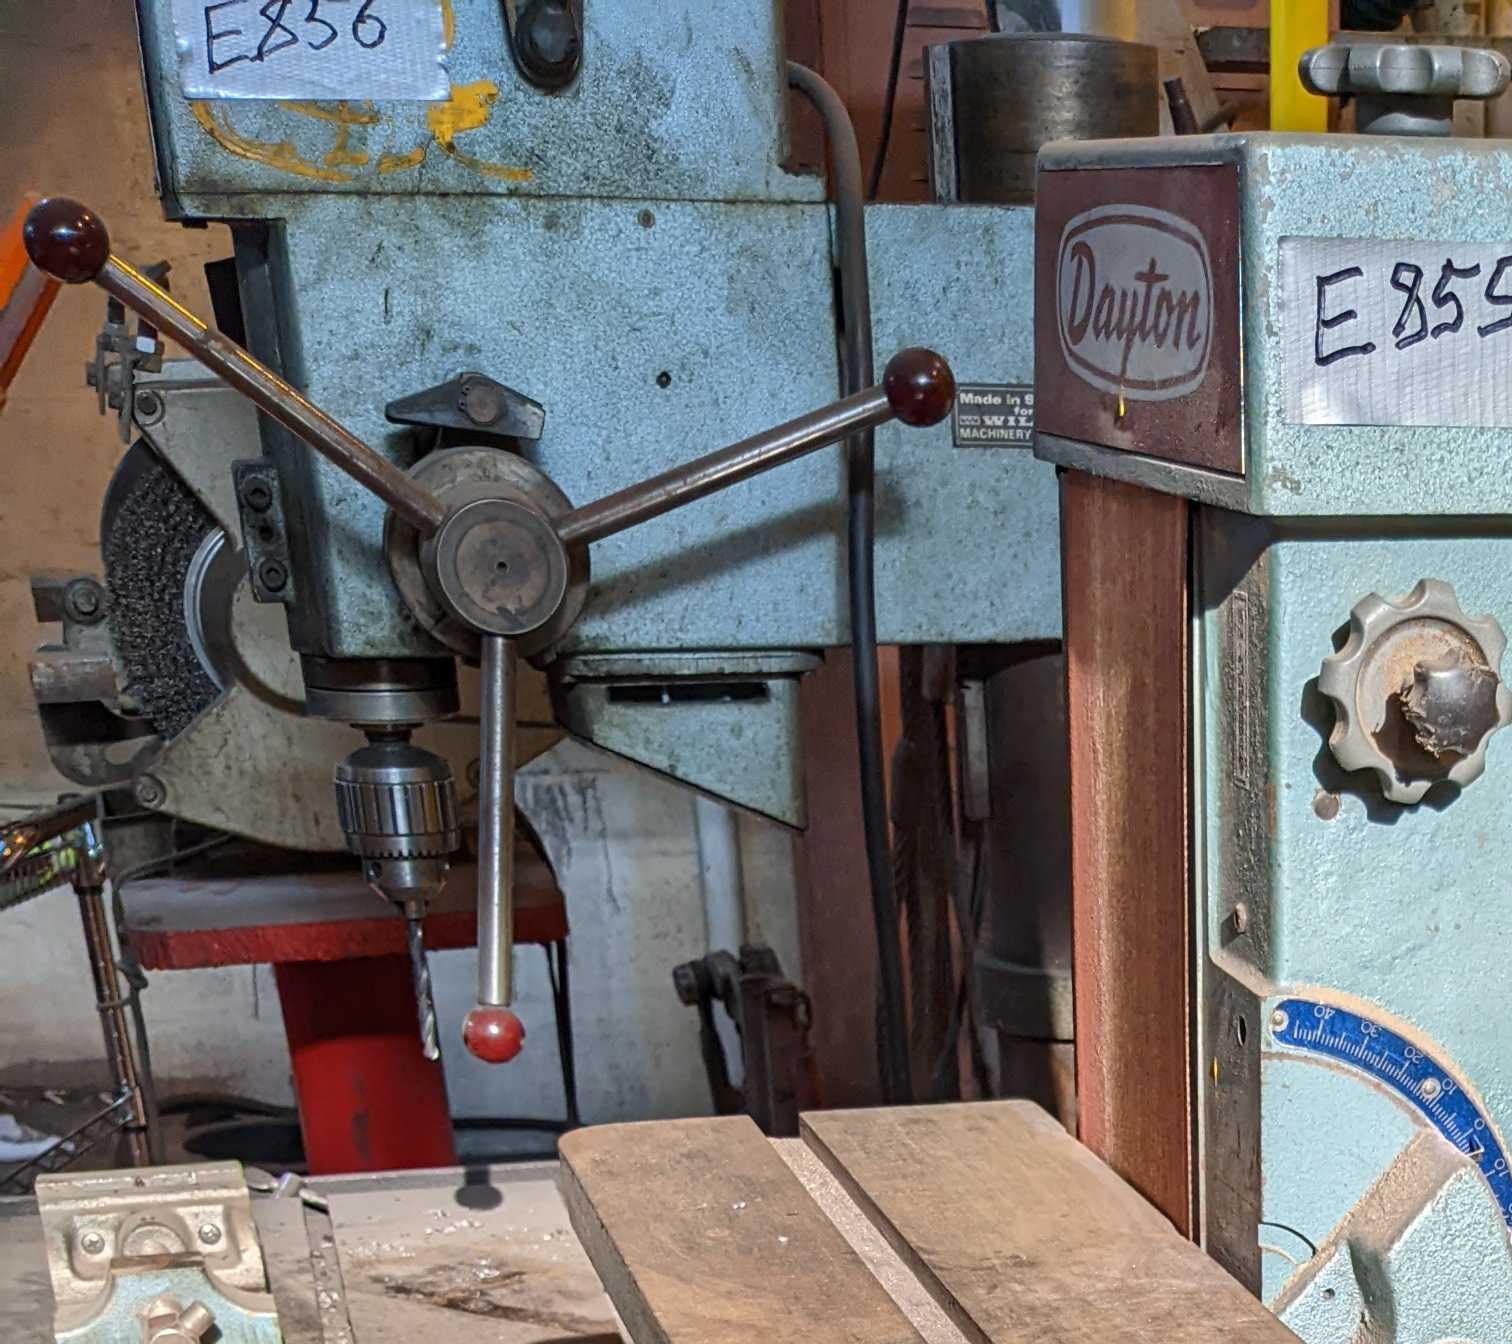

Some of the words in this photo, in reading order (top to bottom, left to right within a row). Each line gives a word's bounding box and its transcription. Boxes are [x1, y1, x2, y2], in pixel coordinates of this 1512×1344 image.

[1067, 241, 1202, 378] Dayton
[959, 393, 1002, 405] Made
[1014, 407, 1034, 416] for
[960, 428, 1032, 440] MACHINERY
[1314, 1005, 1336, 1020] 40
[1360, 1021, 1384, 1038] 30
[1403, 1046, 1426, 1064] 20
[1441, 1078, 1458, 1095] 10
[1474, 1118, 1486, 1132] 0
[1494, 1158, 1510, 1177] 10
